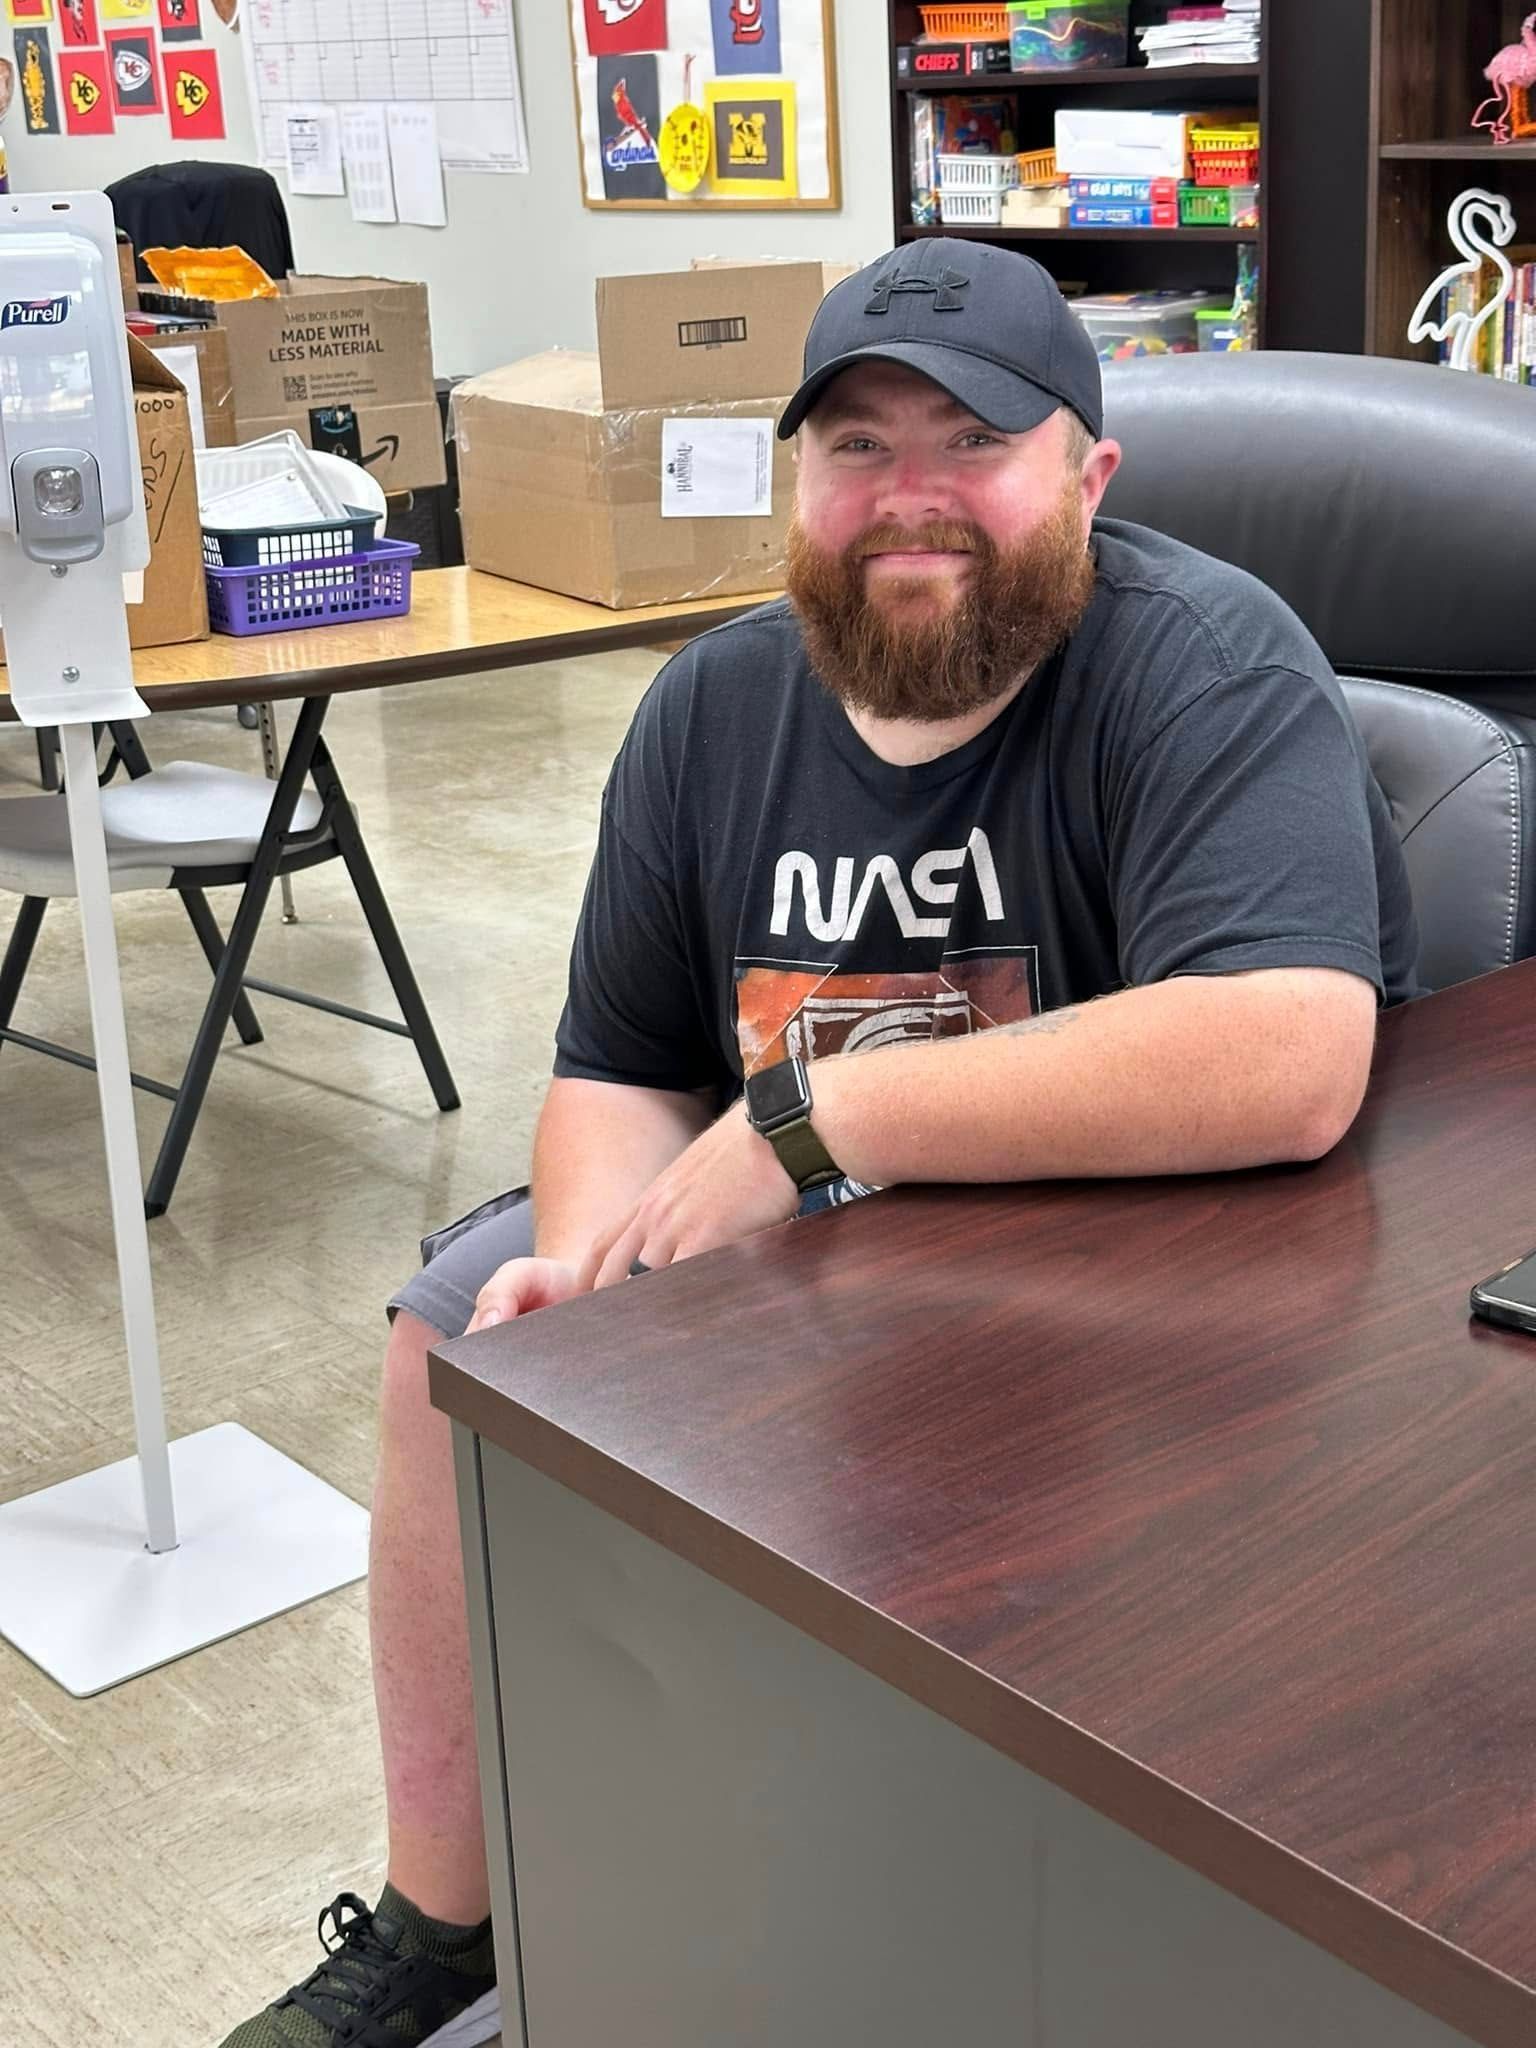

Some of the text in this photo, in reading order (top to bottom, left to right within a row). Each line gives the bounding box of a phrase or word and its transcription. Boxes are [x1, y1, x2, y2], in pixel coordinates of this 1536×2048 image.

[124, 61, 142, 78] KC
[914, 53, 960, 71] CHIEFS
[76, 79, 95, 105] KC
[183, 79, 203, 106] KC
[286, 307, 364, 323] THIS BOX IS NOW
[281, 322, 370, 343] MADE WITH
[269, 339, 384, 363] LESS MATERIAL
[769, 826, 1006, 943] NASA
